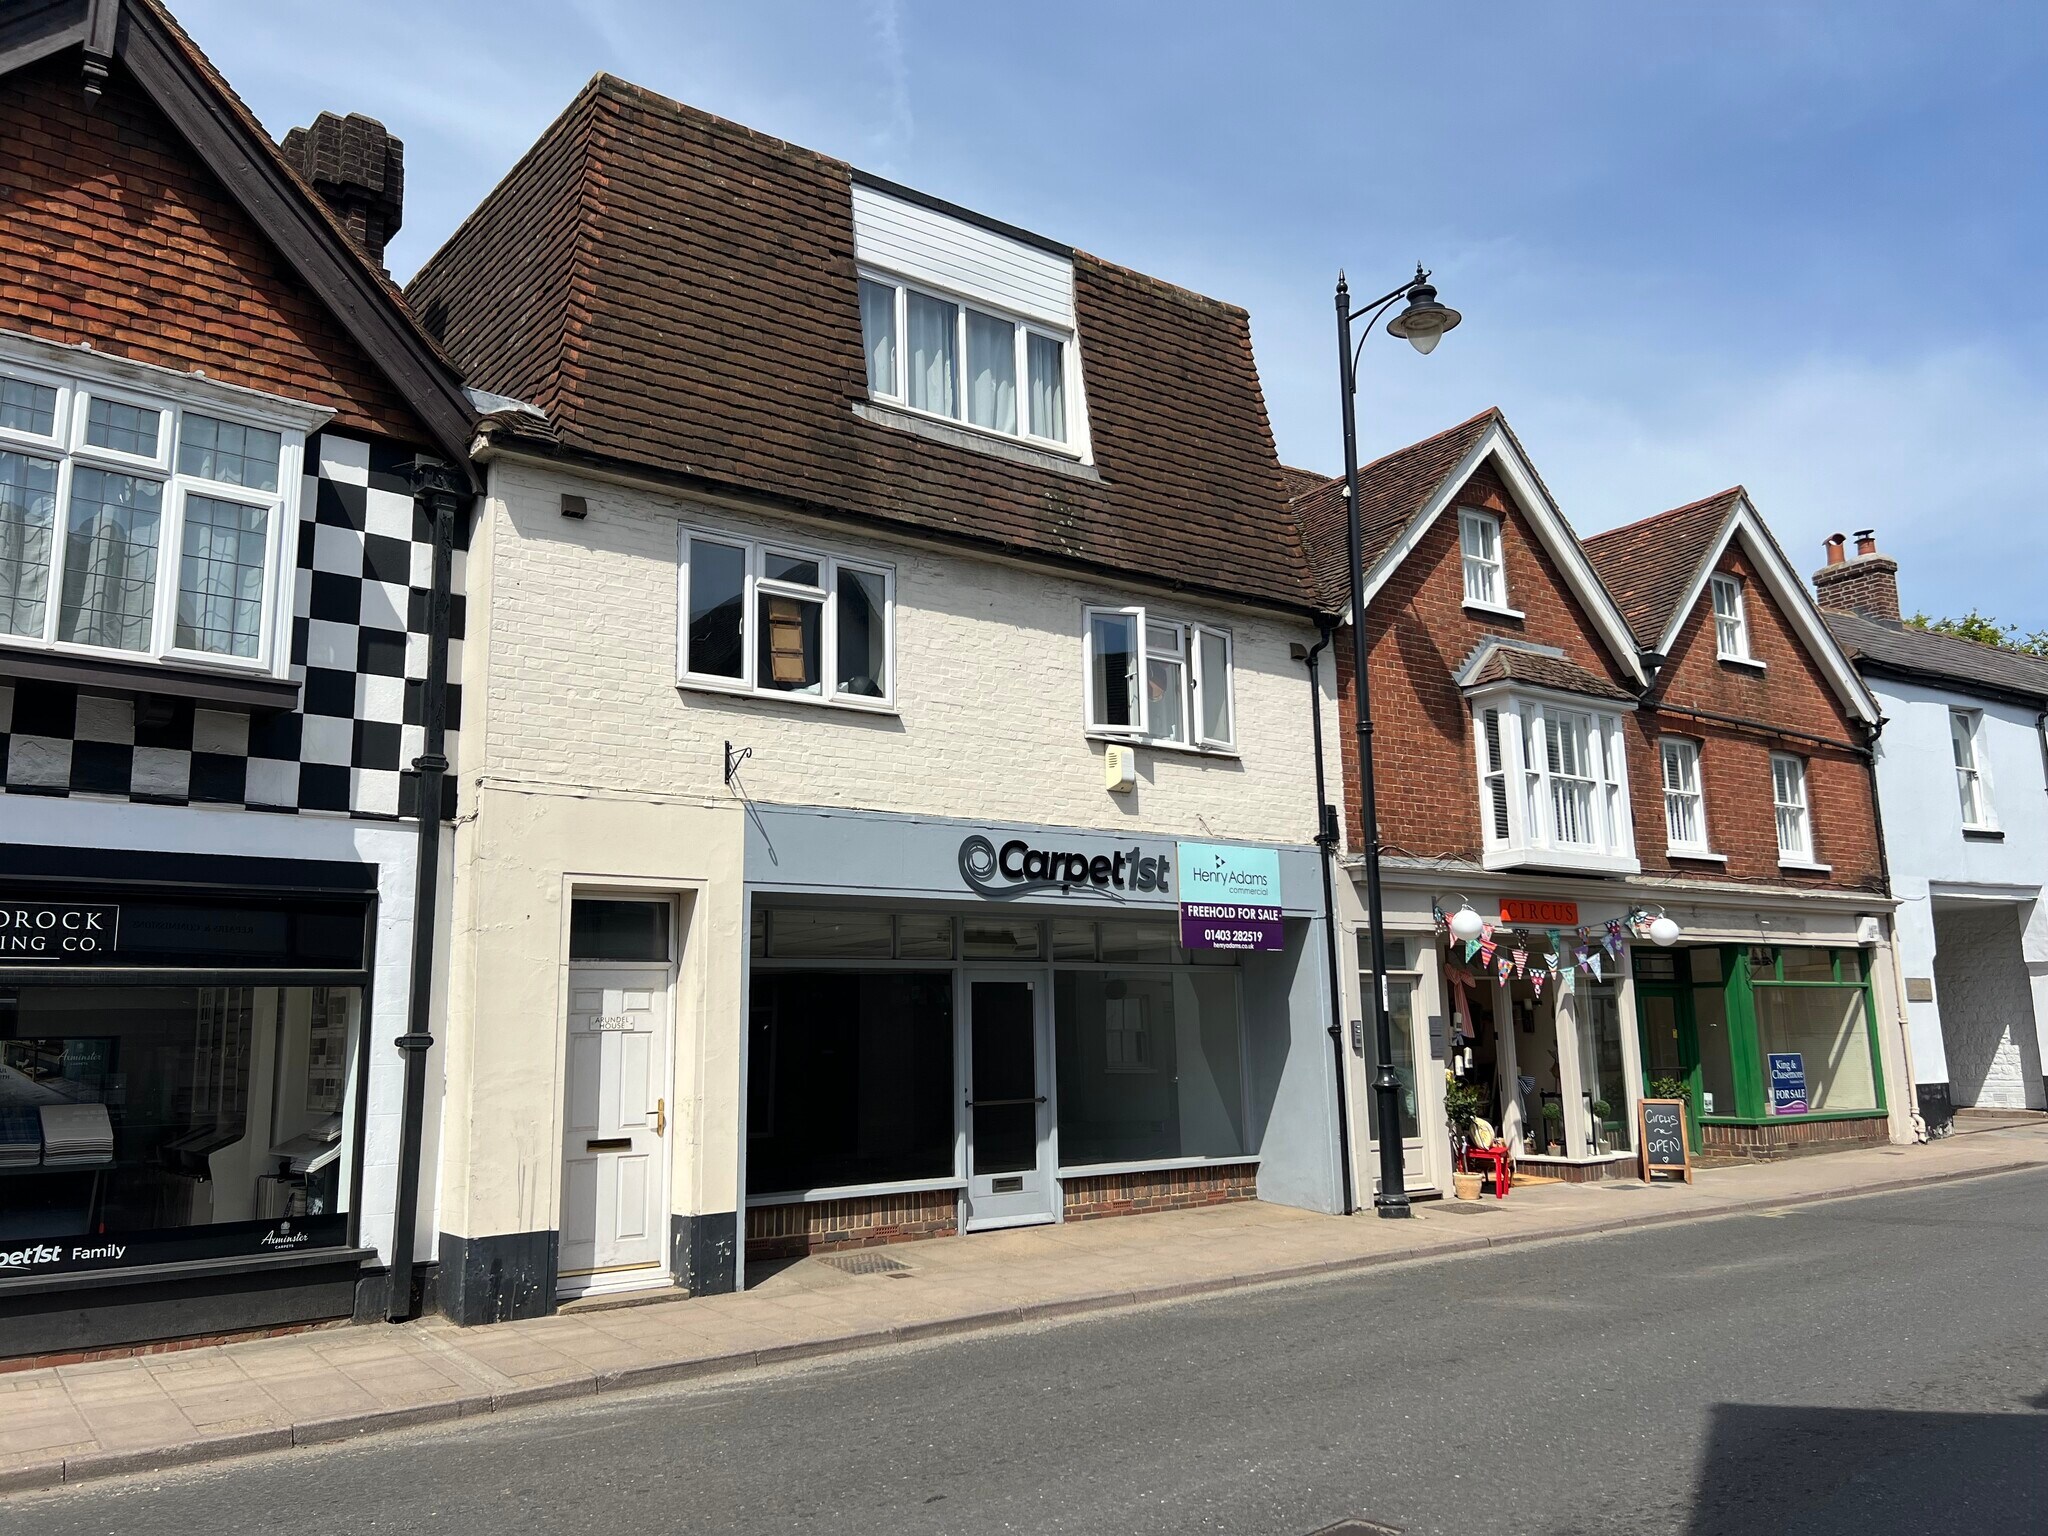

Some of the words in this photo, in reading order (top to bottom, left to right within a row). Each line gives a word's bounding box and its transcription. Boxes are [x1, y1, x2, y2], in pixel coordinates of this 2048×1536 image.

[999, 840, 1170, 894] Carpet1st
[1229, 887, 1268, 896] commercial
[1187, 905, 1236, 918] FREEHOLD
[1237, 907, 1256, 919] FOR
[1257, 909, 1279, 921] SALE
[1507, 902, 1574, 922] CIRCUS
[0, 935, 46, 951] ING
[62, 936, 102, 952] CO.
[1204, 929, 1231, 941] 01403
[1232, 931, 1263, 942] 282519
[1213, 942, 1255, 950] henryadams.co.uk
[1775, 1059, 1791, 1072] King
[1790, 1059, 1797, 1069] &
[1772, 1069, 1804, 1080] Chasemore
[1775, 1089, 1790, 1100] FOR
[1790, 1088, 1806, 1099] SALE
[1644, 1109, 1679, 1127] Circus
[1648, 1136, 1680, 1153] OPEN
[260, 1229, 309, 1245] Axminster
[72, 1244, 127, 1260] Family
